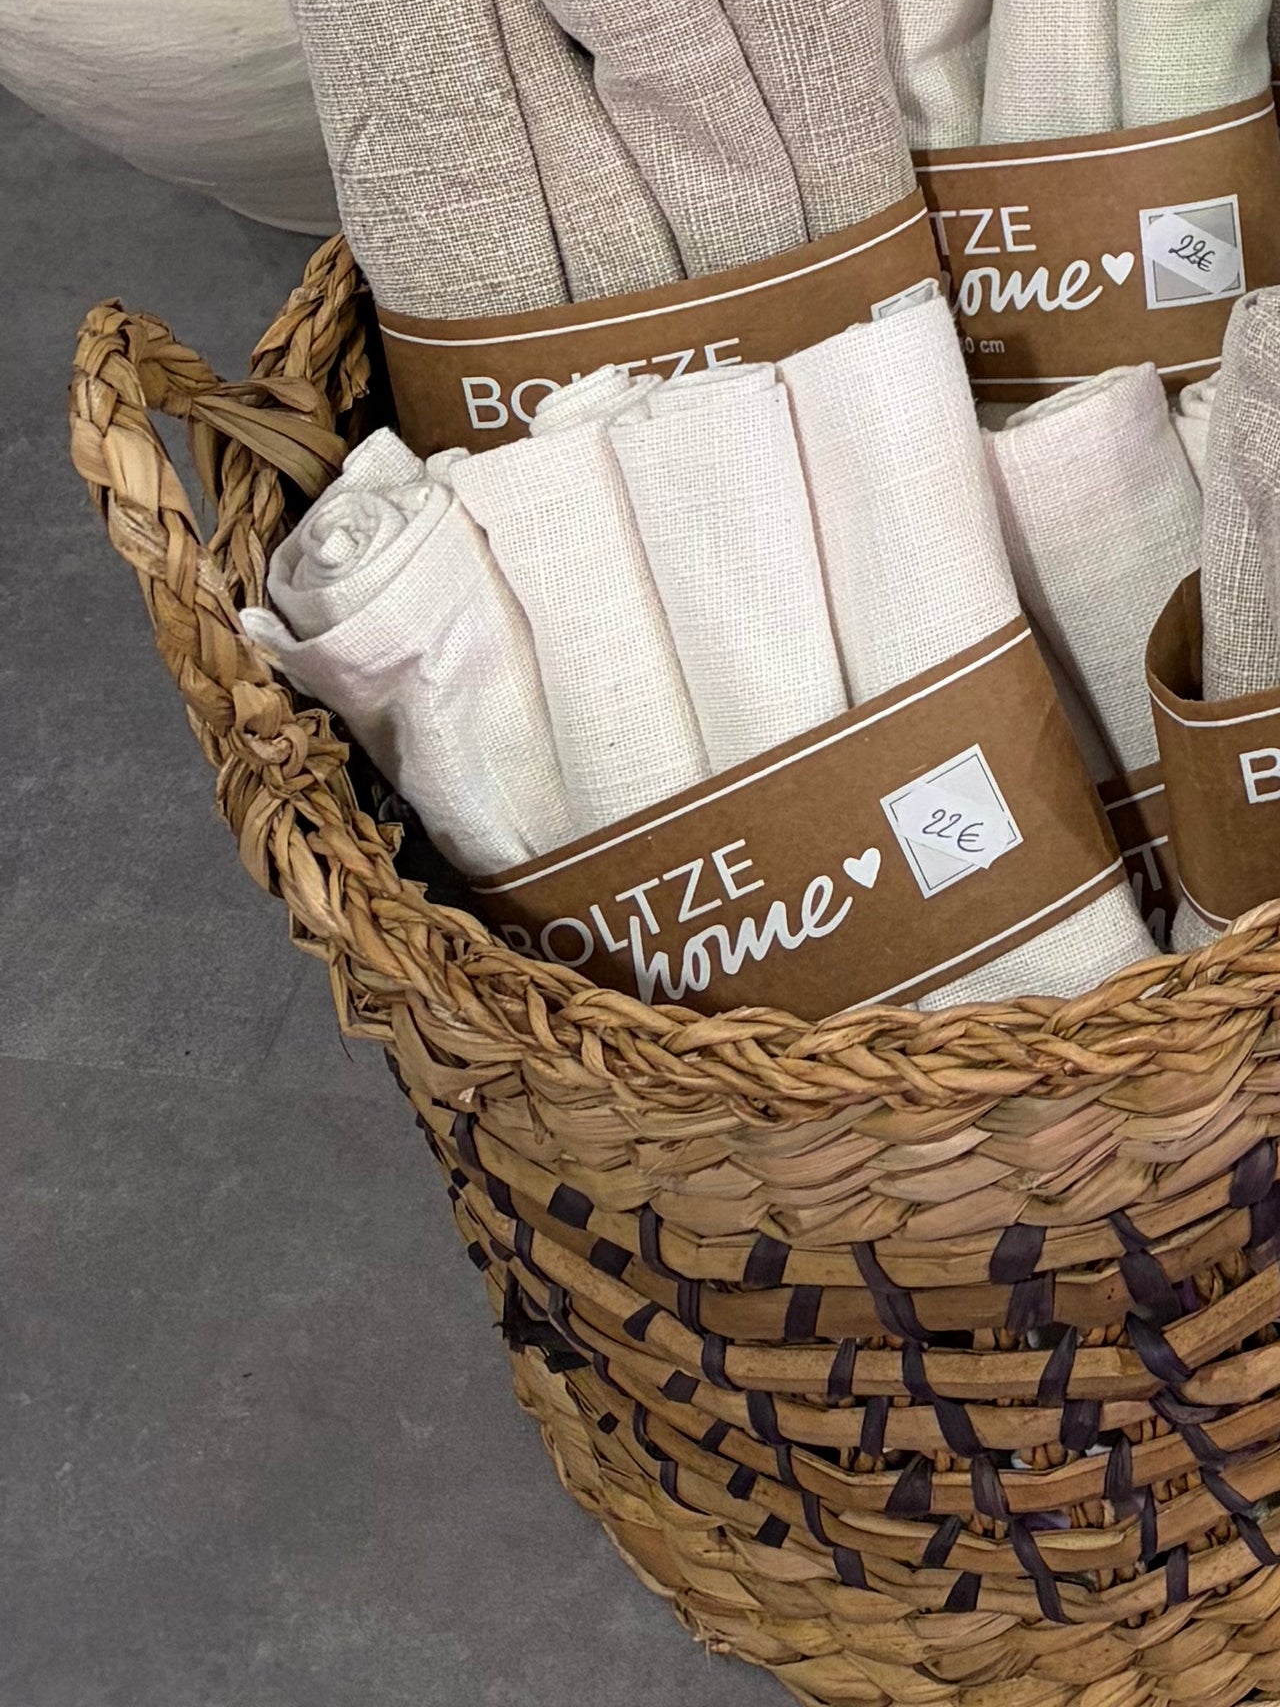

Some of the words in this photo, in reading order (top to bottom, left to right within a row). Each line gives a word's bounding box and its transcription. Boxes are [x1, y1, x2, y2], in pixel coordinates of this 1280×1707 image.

[928, 205, 1037, 256] TZE
[953, 259, 1104, 317] ome
[979, 339, 1006, 354] cm
[921, 808, 985, 853] 22€
[501, 839, 765, 968] BOLTZE
[628, 875, 854, 1005] home
